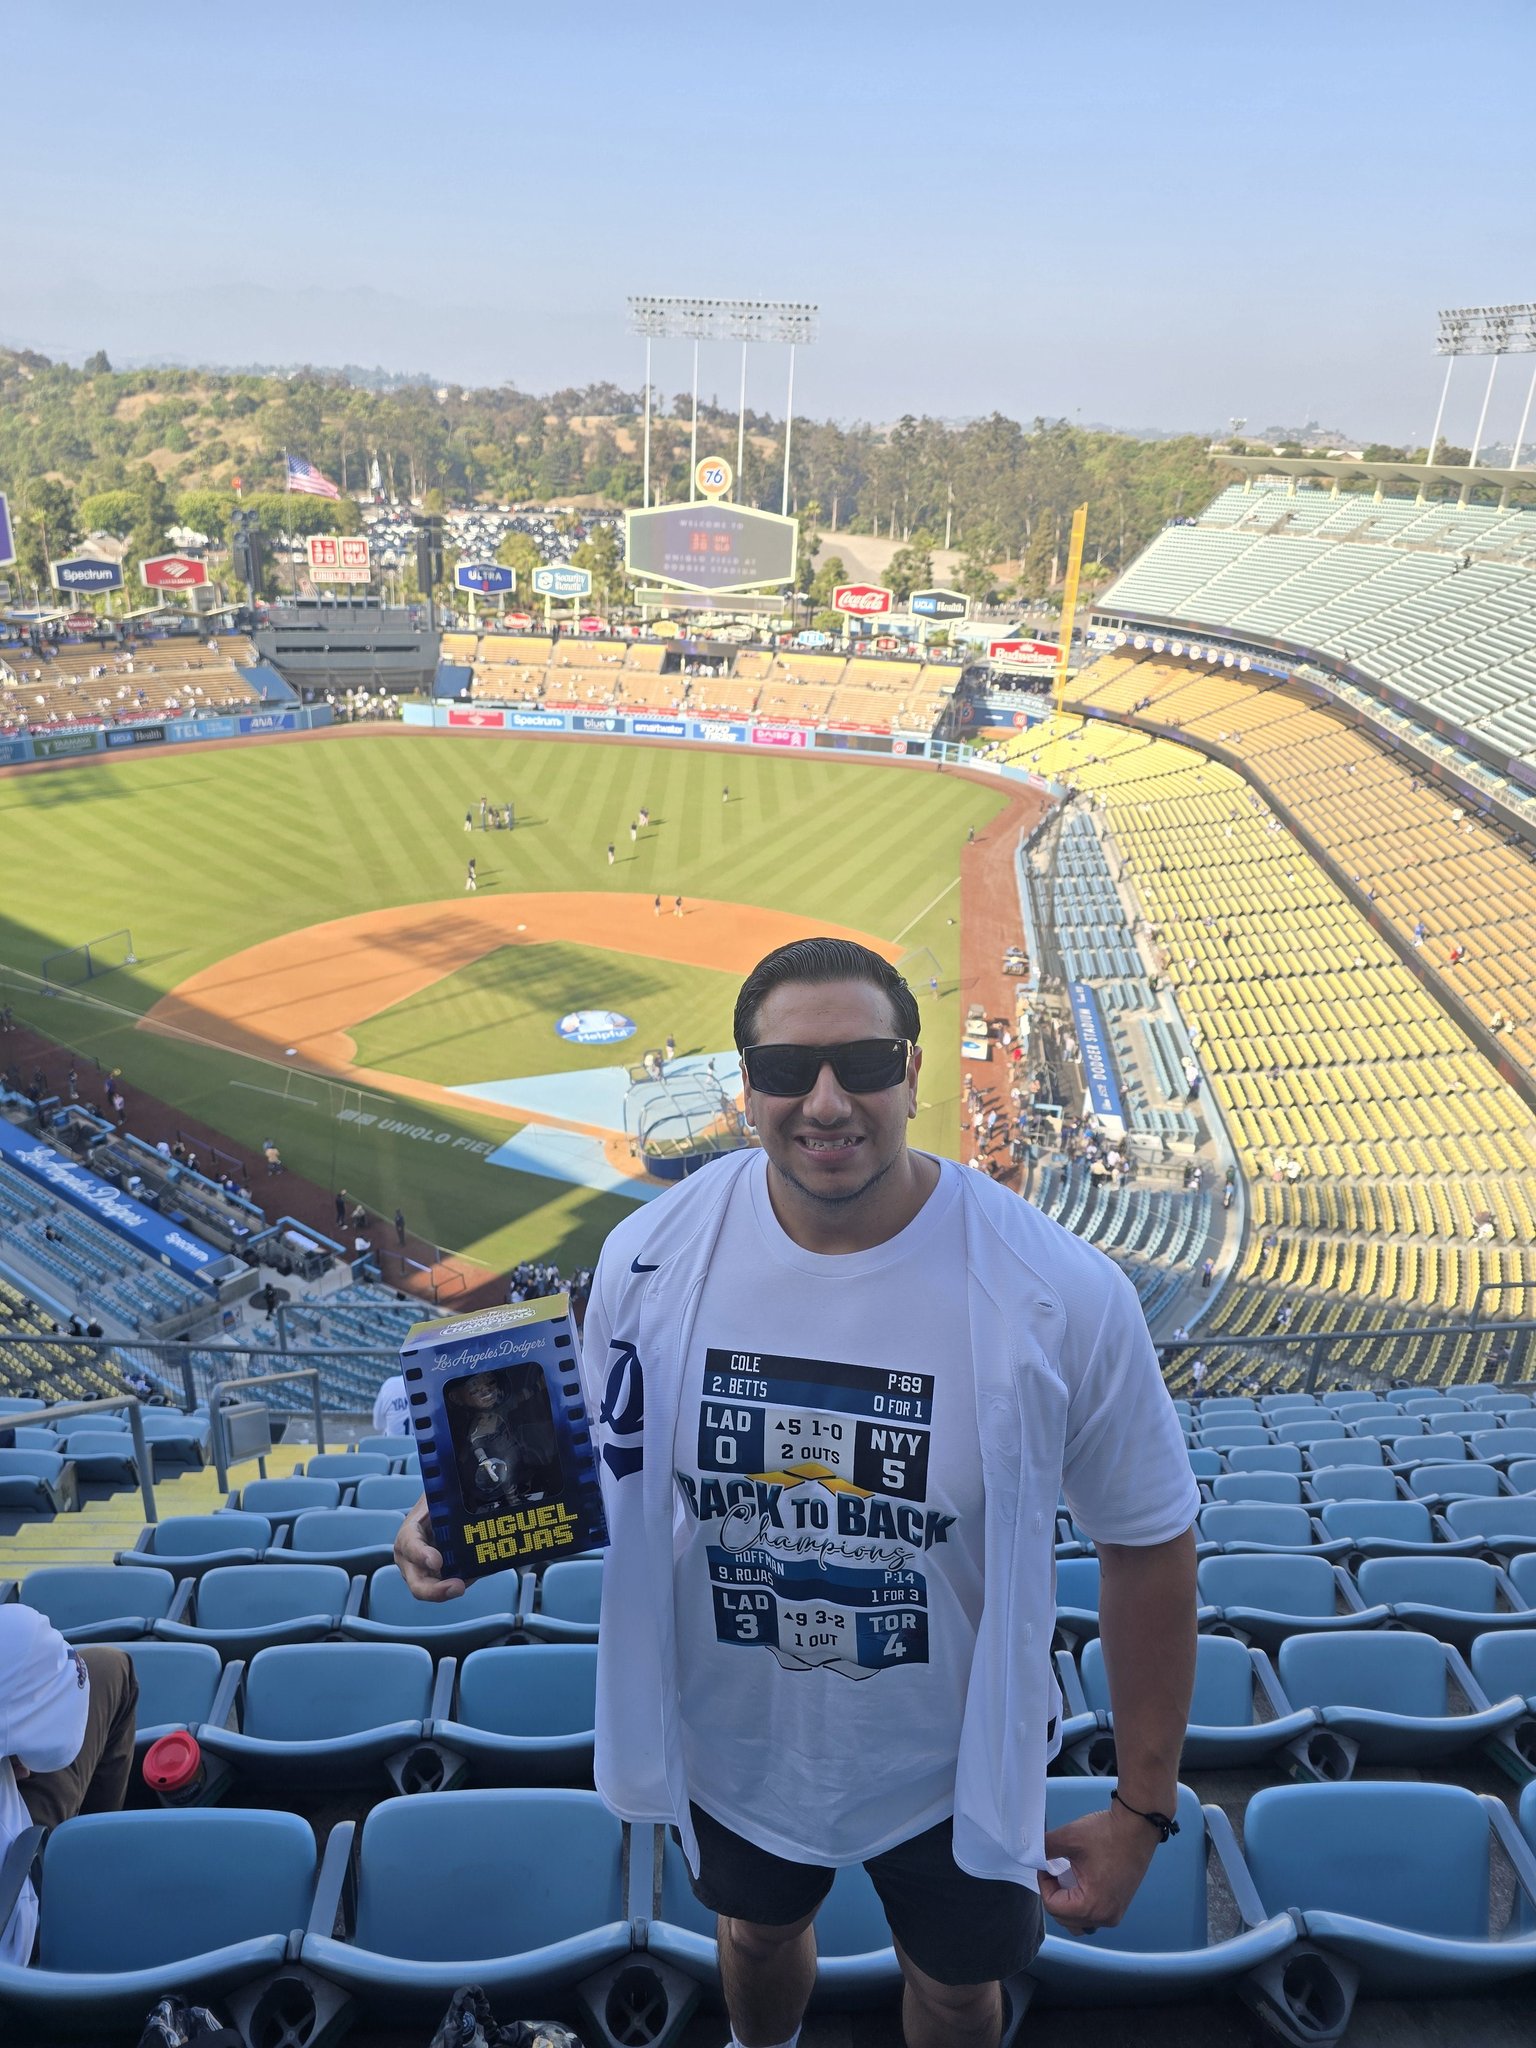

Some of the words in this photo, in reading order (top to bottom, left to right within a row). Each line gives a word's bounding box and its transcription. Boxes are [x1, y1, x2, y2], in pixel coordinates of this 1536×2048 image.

[705, 469, 723, 484] 76
[679, 519, 726, 529] WELCOME
[731, 521, 744, 530] TO
[343, 541, 364, 553] UNI
[62, 569, 113, 583] Spectrum
[467, 570, 503, 581] ULTRA
[711, 564, 757, 575] STADIUM
[837, 590, 886, 611] Coca-Cola
[913, 600, 934, 610] UCLA
[936, 601, 964, 613] Health
[996, 647, 1057, 664] Budweiser
[174, 723, 202, 738] TCL
[251, 717, 273, 728] ANA
[513, 714, 561, 727] Spectrum
[583, 718, 606, 729] blue
[634, 722, 684, 735] smartwater
[113, 734, 132, 743] UCLA
[756, 729, 790, 741] DAISO
[1079, 1008, 1098, 1042] STADIUM
[577, 1029, 628, 1042] Helpful
[1086, 1045, 1107, 1080] DODGER
[377, 1118, 452, 1144] UNIQLO
[452, 1136, 496, 1156] FIEL
[164, 1231, 209, 1262] Spectrum
[431, 1353, 452, 1372] Los
[452, 1347, 498, 1370] Angeles
[497, 1337, 546, 1358] Dodgers
[730, 1354, 761, 1373] COLE
[712, 1376, 726, 1393] 2.
[728, 1377, 768, 1398] BETTS
[888, 1373, 922, 1394] P:69
[705, 1406, 752, 1432] LAD
[888, 1401, 910, 1416] FOR
[915, 1401, 922, 1418] 1
[788, 1419, 801, 1436] 5
[812, 1420, 843, 1441] 1-0
[715, 1435, 737, 1465] 0
[870, 1428, 922, 1457] NYY
[781, 1443, 794, 1460] 2
[801, 1446, 841, 1465] OUTS
[882, 1458, 906, 1490] 5
[677, 1471, 785, 1529] BACK
[791, 1497, 829, 1530] TO
[837, 1492, 957, 1552] BACK
[463, 1502, 578, 1545] MIGUEL
[475, 1524, 575, 1564] ROJAS
[720, 1503, 916, 1572] Champions
[735, 1550, 785, 1576] HOFFMAN
[718, 1566, 733, 1581] 9.
[735, 1568, 774, 1587] ROJAS
[884, 1571, 915, 1585] P:14
[722, 1592, 769, 1612] LAD
[871, 1589, 880, 1603] 1
[883, 1589, 905, 1602] FOR
[909, 1589, 919, 1601] 3
[735, 1613, 759, 1639] 3
[795, 1612, 808, 1627] 9
[815, 1610, 845, 1630] 3-2
[868, 1613, 917, 1634] TOR
[795, 1633, 804, 1648] 1
[809, 1633, 838, 1648] OUT
[883, 1632, 907, 1659] 4
